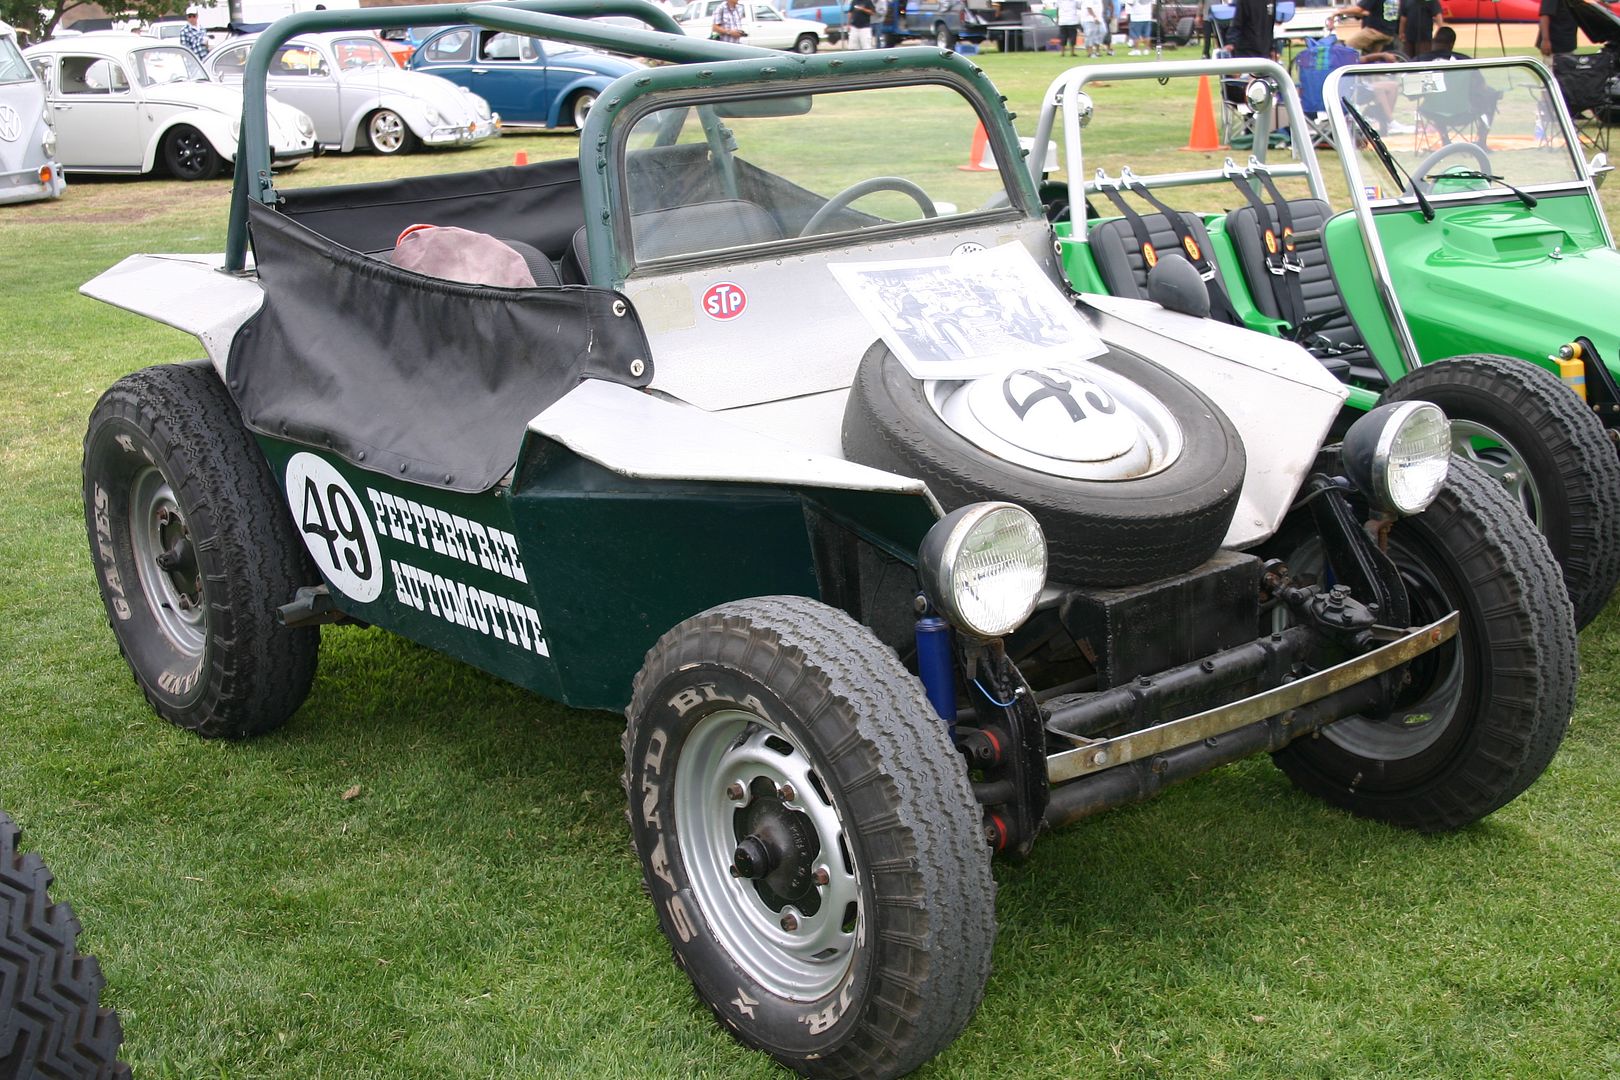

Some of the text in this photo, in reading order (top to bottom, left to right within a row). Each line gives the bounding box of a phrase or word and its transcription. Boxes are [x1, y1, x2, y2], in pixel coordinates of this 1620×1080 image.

[707, 286, 742, 315] STP
[94, 481, 132, 621] GATES
[302, 476, 373, 581] 49
[366, 487, 529, 584] PEPPERTREE
[390, 559, 551, 658] AUTOMOTIVE
[642, 729, 698, 943] SAND
